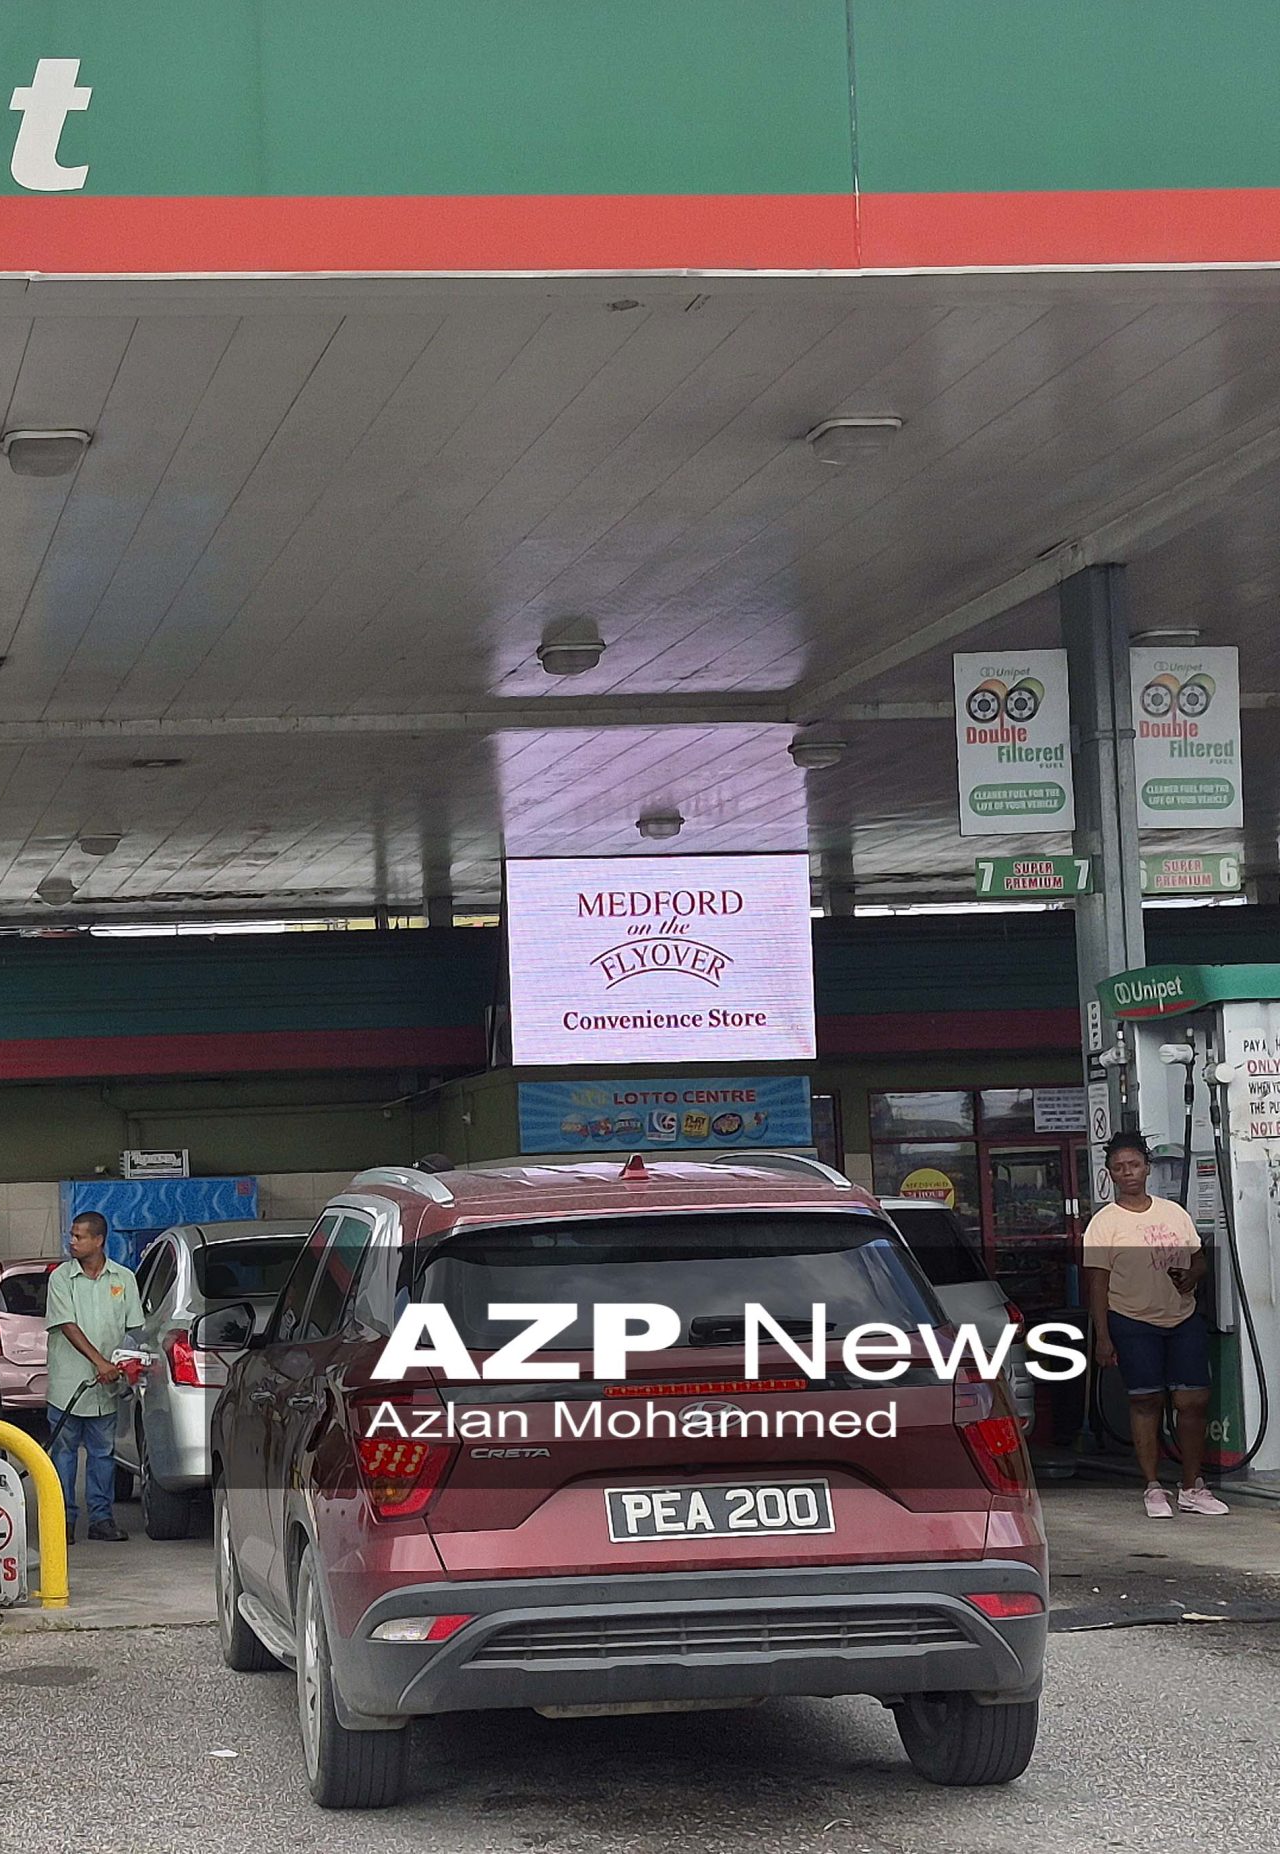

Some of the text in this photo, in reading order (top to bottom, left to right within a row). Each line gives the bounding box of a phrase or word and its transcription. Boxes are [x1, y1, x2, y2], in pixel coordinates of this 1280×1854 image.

[996, 667, 1031, 681] Unipet
[1170, 662, 1203, 676] Unipet
[966, 722, 1027, 745] Double
[1139, 719, 1198, 740] Double
[997, 743, 1064, 764] Filtered
[1170, 739, 1234, 758] Filtered
[978, 860, 1089, 892] 7 SUPER 7
[1154, 873, 1212, 887] PREMIUM
[1163, 857, 1238, 887] SUPER 6
[1004, 876, 1064, 890] PREMIUM
[576, 889, 744, 918] MEDFORD
[627, 915, 690, 935] on the
[600, 943, 726, 982] FLYOVER
[1131, 976, 1183, 1012] Unipet
[562, 1008, 767, 1030] Convenience Store
[1244, 1040, 1260, 1052] PAY
[1247, 1060, 1280, 1074] ONLY
[613, 1092, 678, 1105] LOTTO
[682, 1089, 756, 1104] CENTRE
[1250, 1102, 1266, 1114] THE
[1251, 1121, 1274, 1136] NOT
[470, 1447, 551, 1459] CRETA
[622, 1487, 819, 1534] PEA 200
